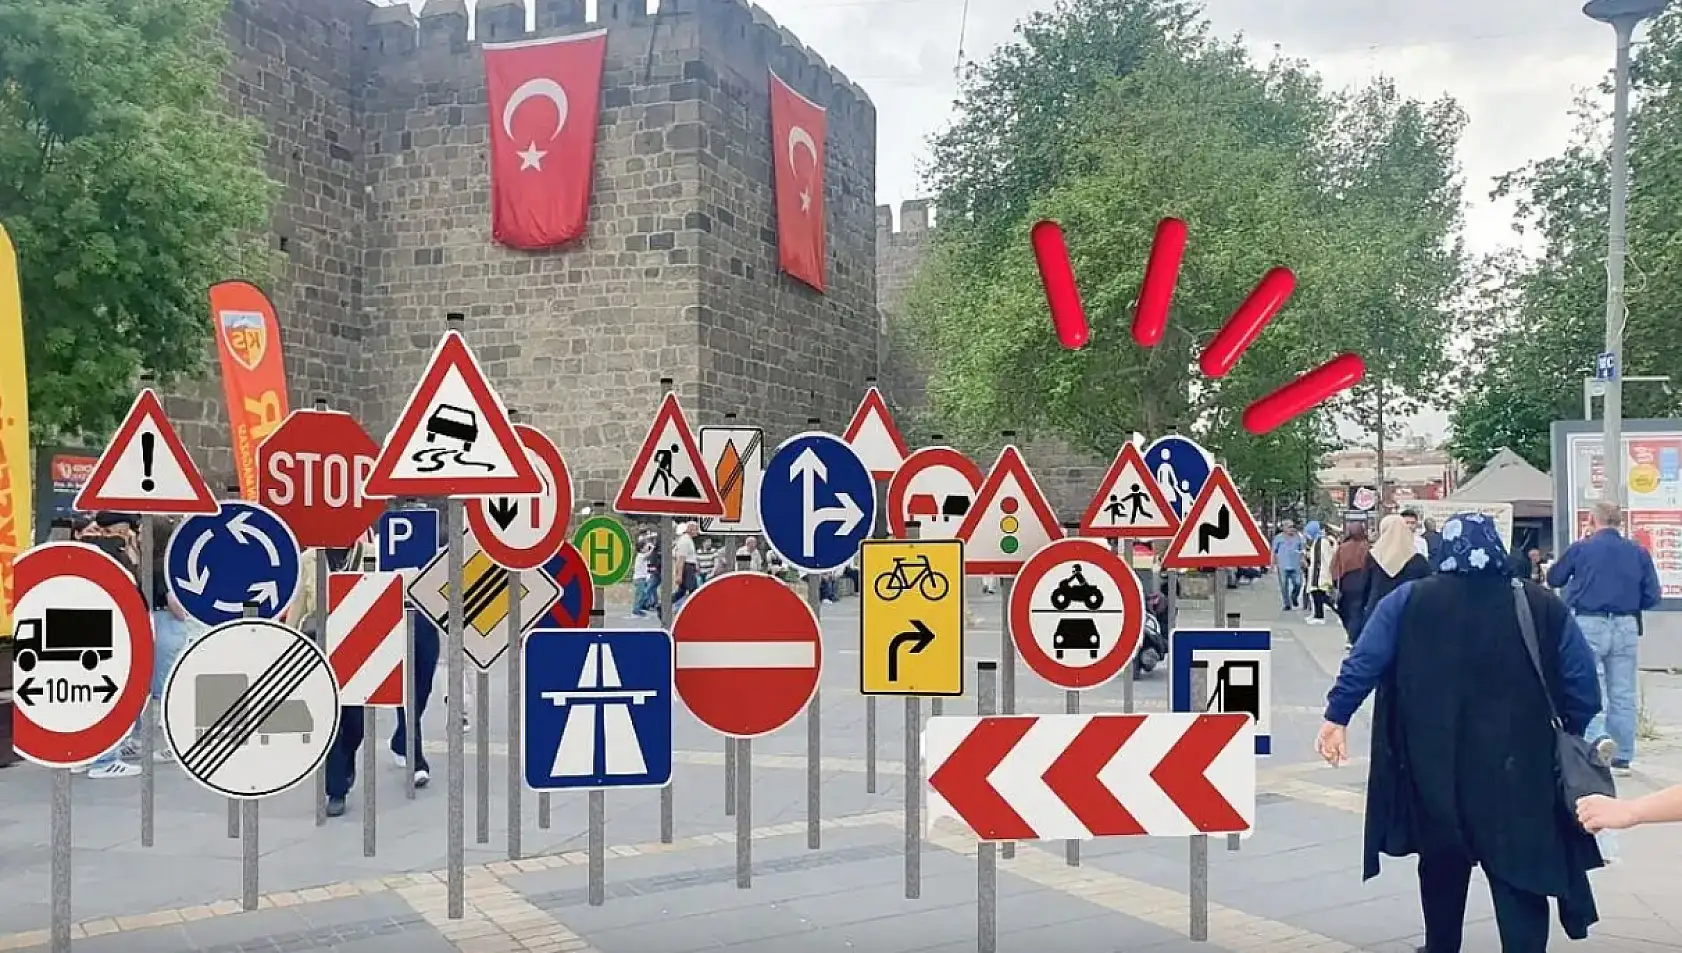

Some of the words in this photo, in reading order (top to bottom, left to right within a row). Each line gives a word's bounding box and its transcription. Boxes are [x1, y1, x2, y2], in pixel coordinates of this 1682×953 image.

[267, 451, 374, 508] STOP
[388, 517, 412, 555] P
[589, 531, 614, 573] H
[46, 678, 91, 703] 10m
